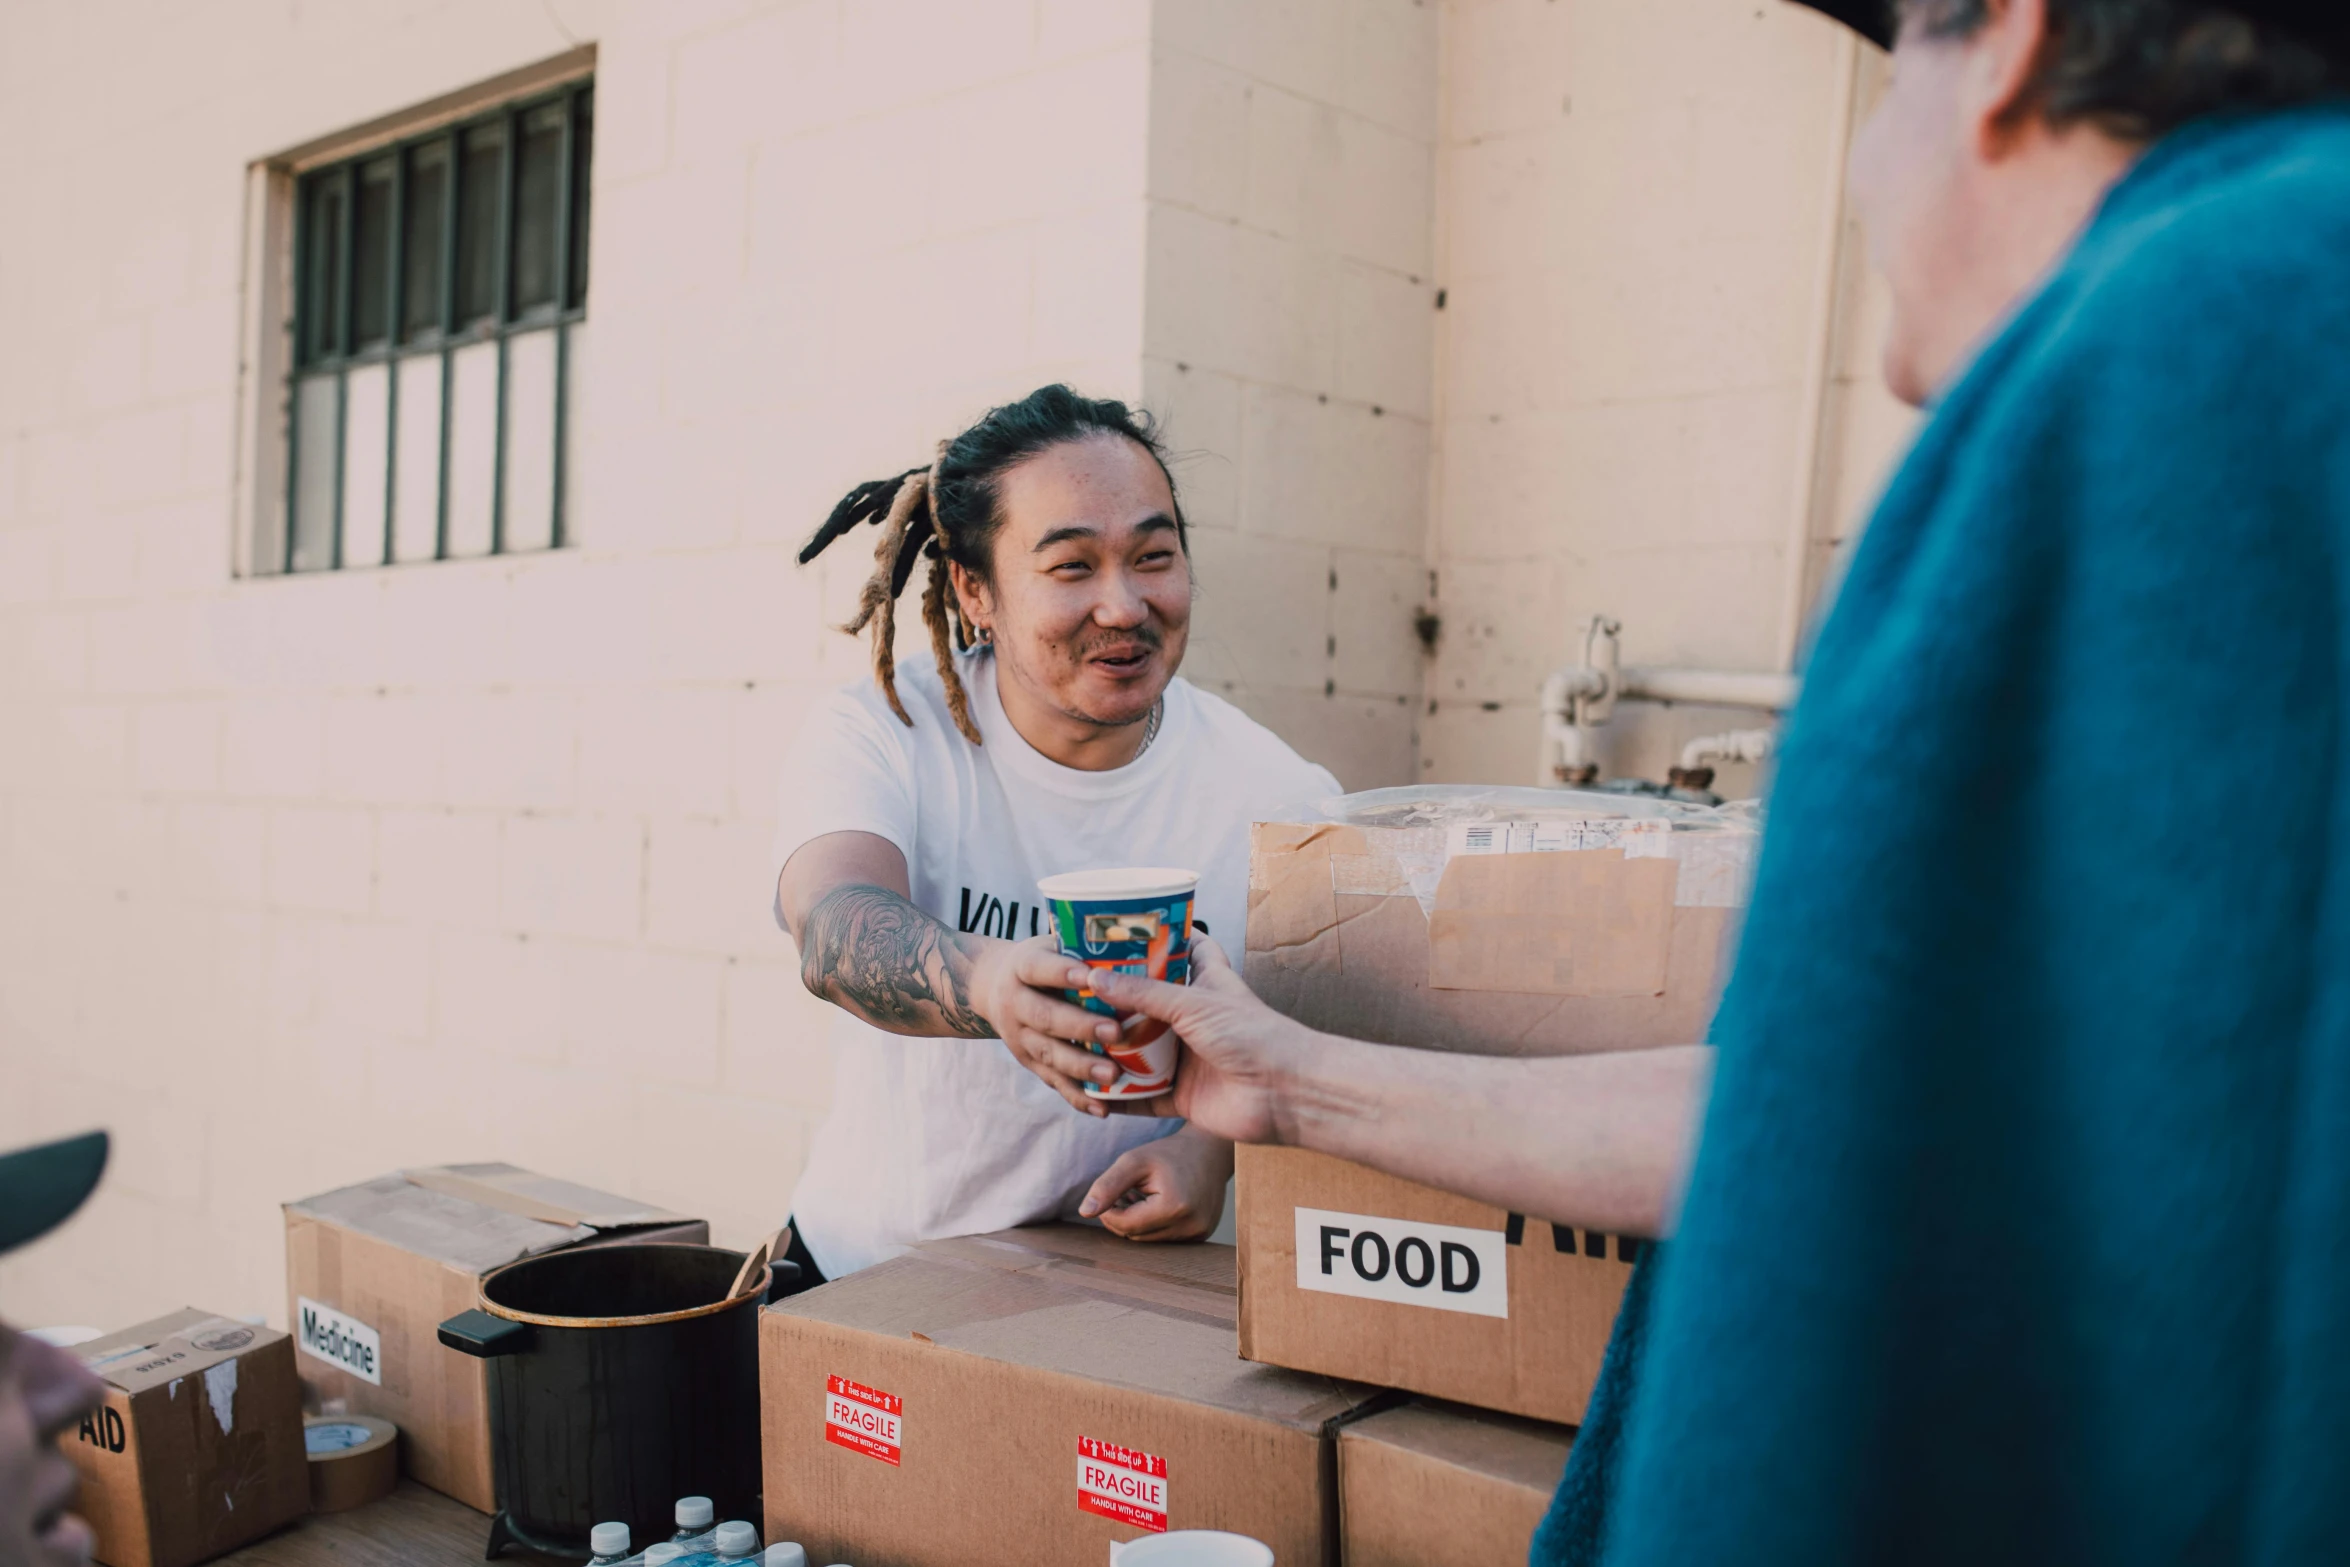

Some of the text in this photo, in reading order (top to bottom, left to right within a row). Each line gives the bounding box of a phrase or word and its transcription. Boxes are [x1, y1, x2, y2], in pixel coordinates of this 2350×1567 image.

[1319, 1225, 1481, 1294] FOOD
[302, 1305, 373, 1374] Medicine
[848, 1386, 881, 1404] THIS SIDE UP
[79, 1403, 126, 1454] AID
[833, 1401, 895, 1440] FRAGILE
[837, 1430, 889, 1455] HANDLE WITH CARE
[1103, 1450, 1142, 1467] THIS SIDE UP
[1086, 1465, 1160, 1505] FRAGILE
[1091, 1496, 1153, 1522] HANDLE WITH CARE
